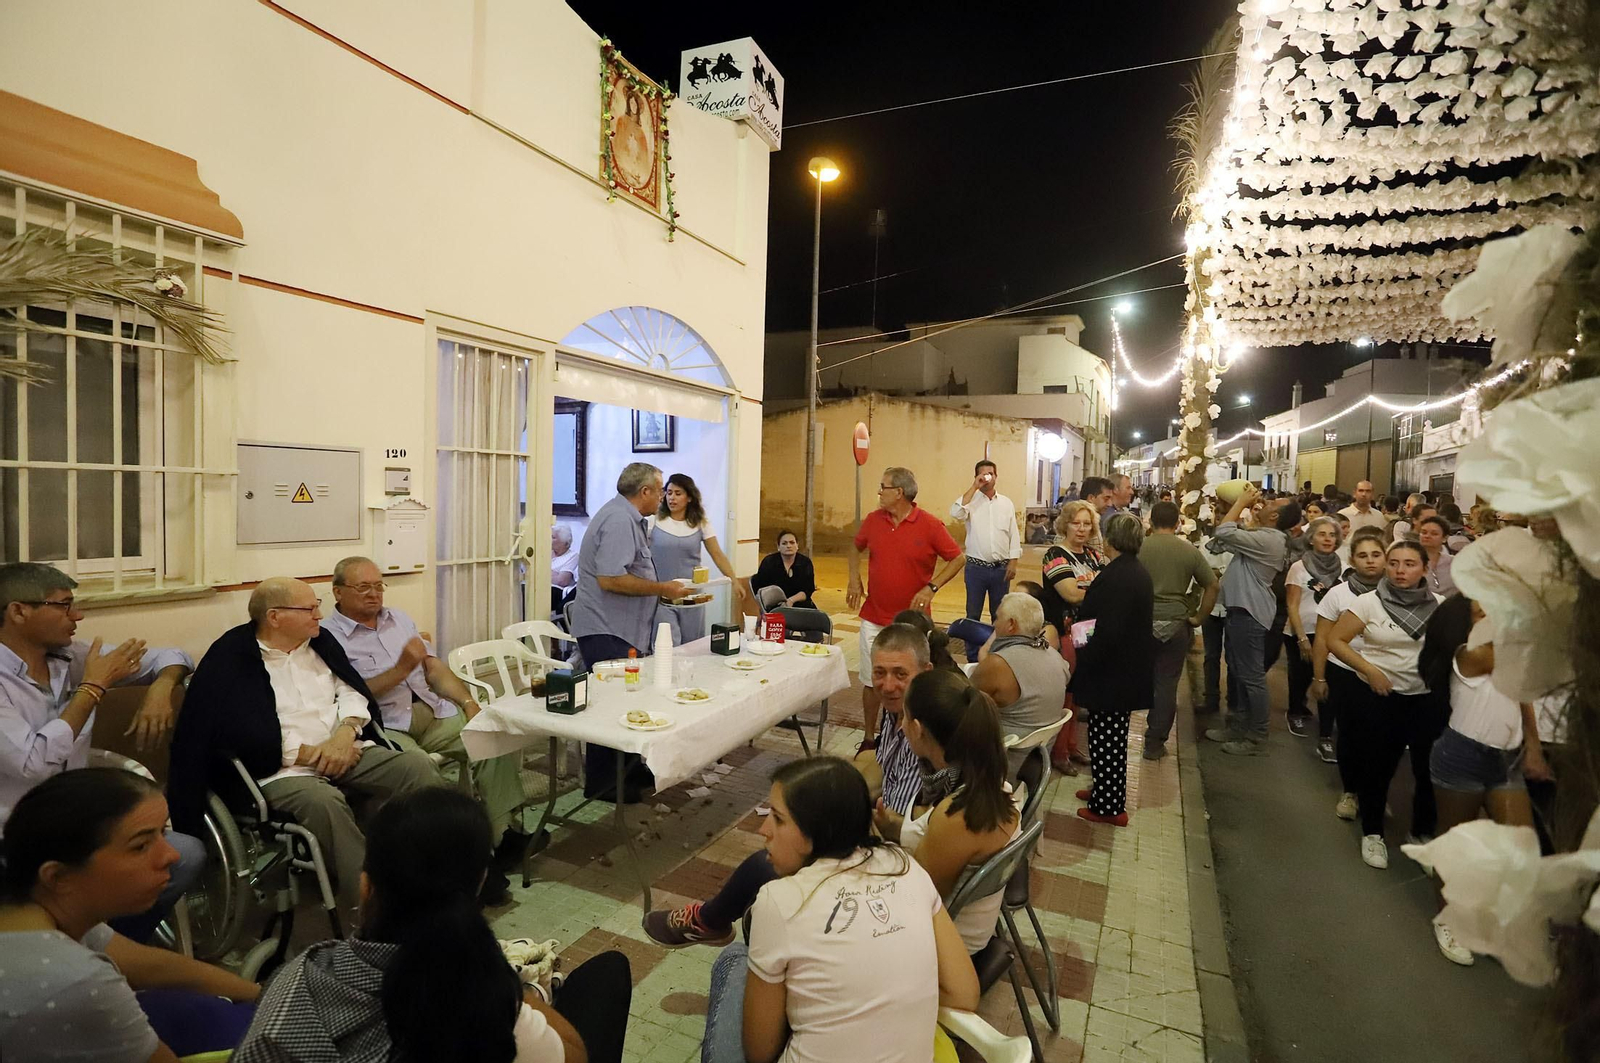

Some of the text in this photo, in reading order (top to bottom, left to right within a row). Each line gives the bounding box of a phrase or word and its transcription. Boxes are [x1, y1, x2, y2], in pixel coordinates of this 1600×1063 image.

[687, 91, 746, 112] Acosta
[748, 95, 780, 139] Acosta
[385, 449, 407, 458] 120
[823, 897, 859, 935] 19
